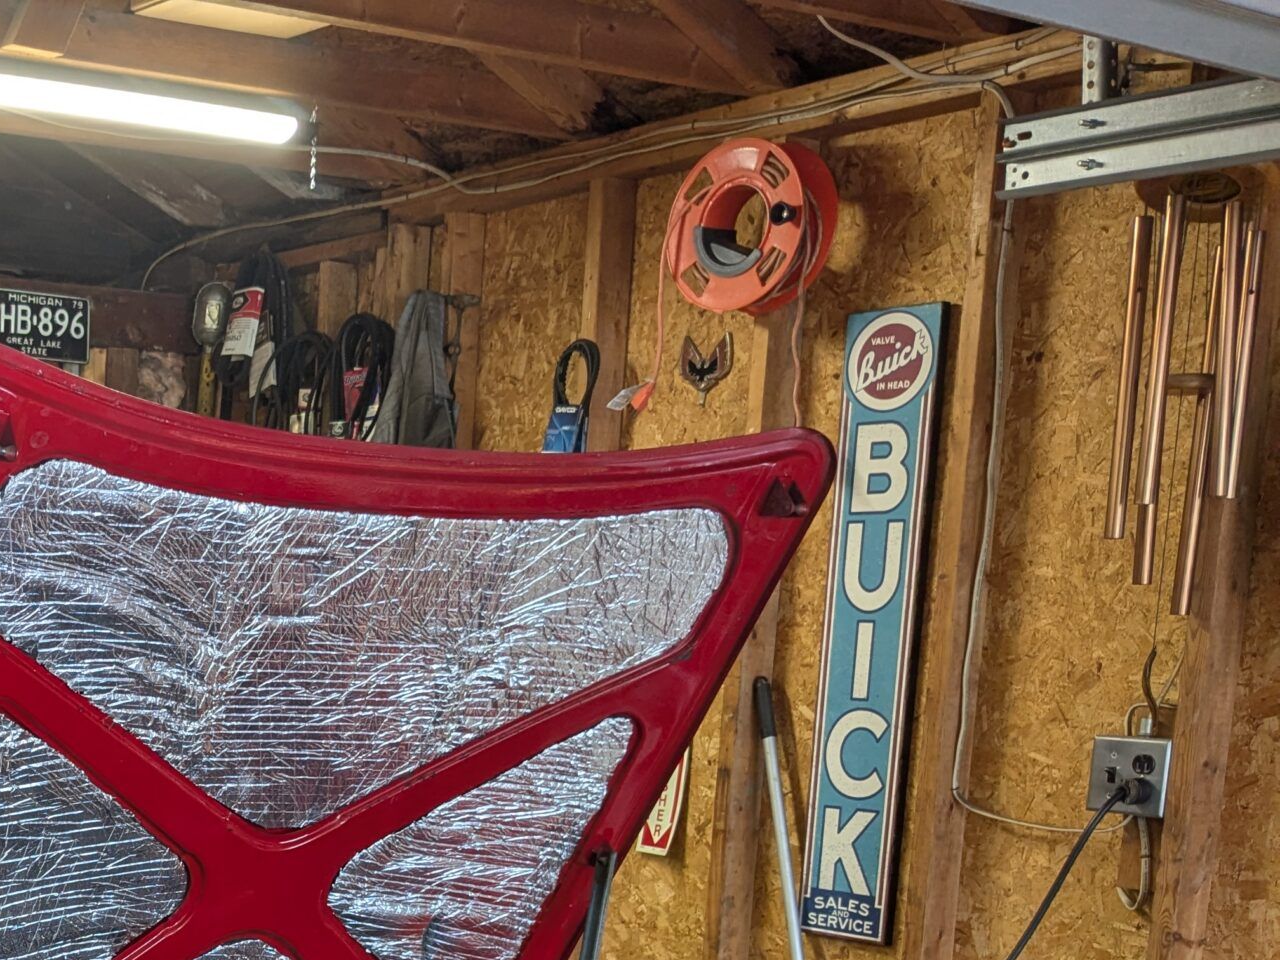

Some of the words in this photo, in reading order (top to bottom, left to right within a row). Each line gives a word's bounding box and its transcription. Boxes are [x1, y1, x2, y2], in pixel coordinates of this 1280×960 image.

[8, 293, 63, 306] MICHIGAN
[72, 300, 84, 309] 79
[6, 336, 34, 346] GREAT
[40, 340, 62, 349] LAKE
[871, 335, 896, 346] VALVE
[21, 347, 48, 356] STATE
[856, 329, 928, 392] Buick
[876, 382, 885, 391] IN
[887, 379, 910, 390] HEAD
[818, 422, 910, 896] BUICK
[814, 896, 870, 916] SALES
[831, 909, 850, 918] AND
[807, 912, 873, 934] SERVICE
